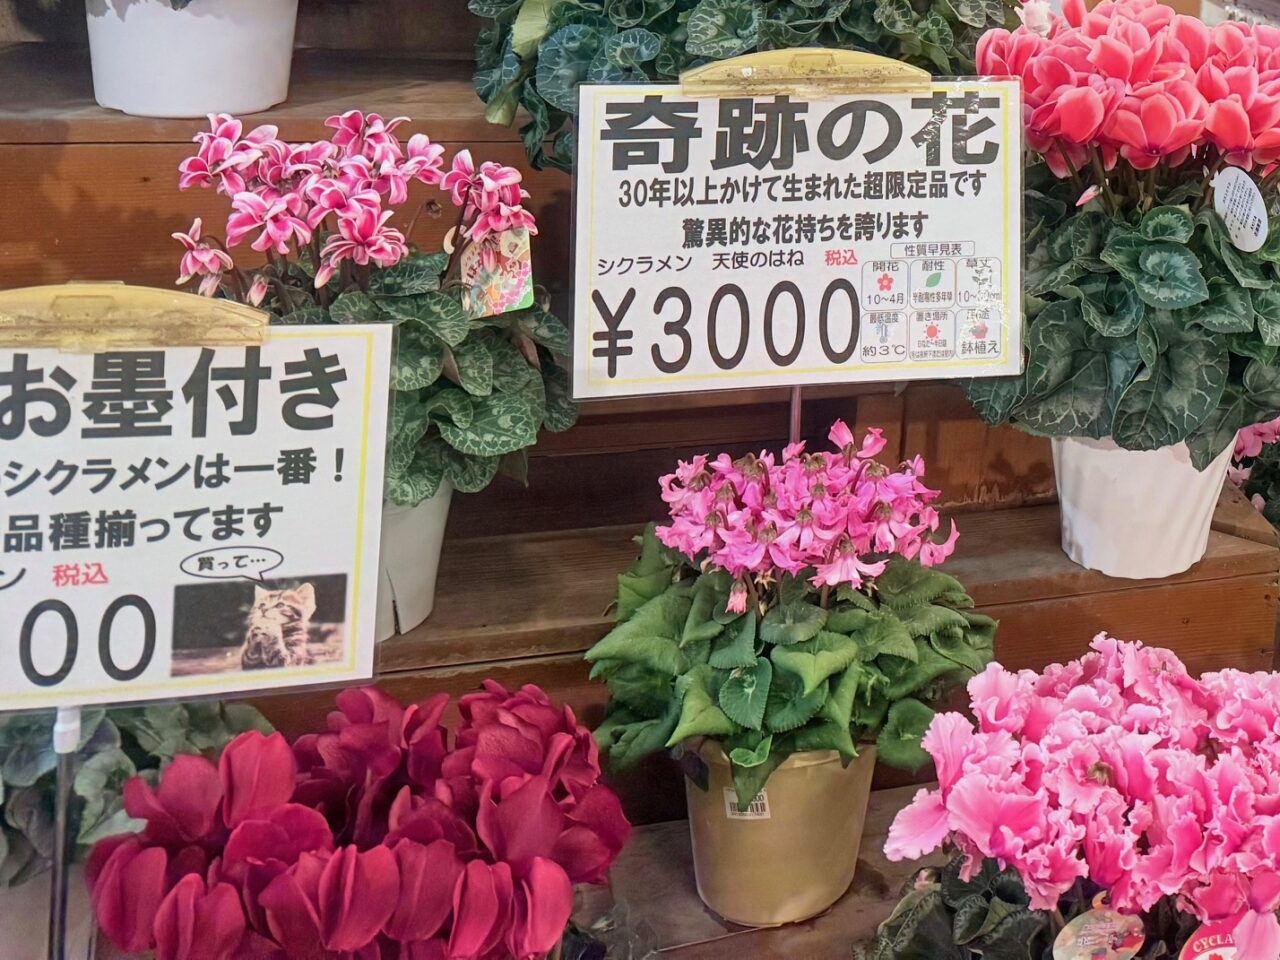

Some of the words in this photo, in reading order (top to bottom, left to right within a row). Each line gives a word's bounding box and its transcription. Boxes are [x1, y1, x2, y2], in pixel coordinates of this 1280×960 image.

[599, 91, 1001, 174] 奇跡の花
[618, 169, 989, 209] 30年以上かけて生まれた超限定品です
[681, 209, 930, 250] 驚異的な花持ちを誇ります
[597, 253, 692, 277] シクラメン
[711, 249, 805, 271] 天使のはね
[824, 247, 859, 266] 税込
[872, 260, 900, 273] 開花
[921, 259, 946, 272] 耐性
[903, 242, 963, 257] 性質早見表
[591, 277, 861, 379] ¥3000
[960, 340, 1000, 355] 鉢植え
[0, 345, 349, 441] お墨付き
[3, 502, 285, 553] 品種揃ってます
[52, 561, 110, 588] 税込
[1192, 933, 1237, 953] CYCLA
